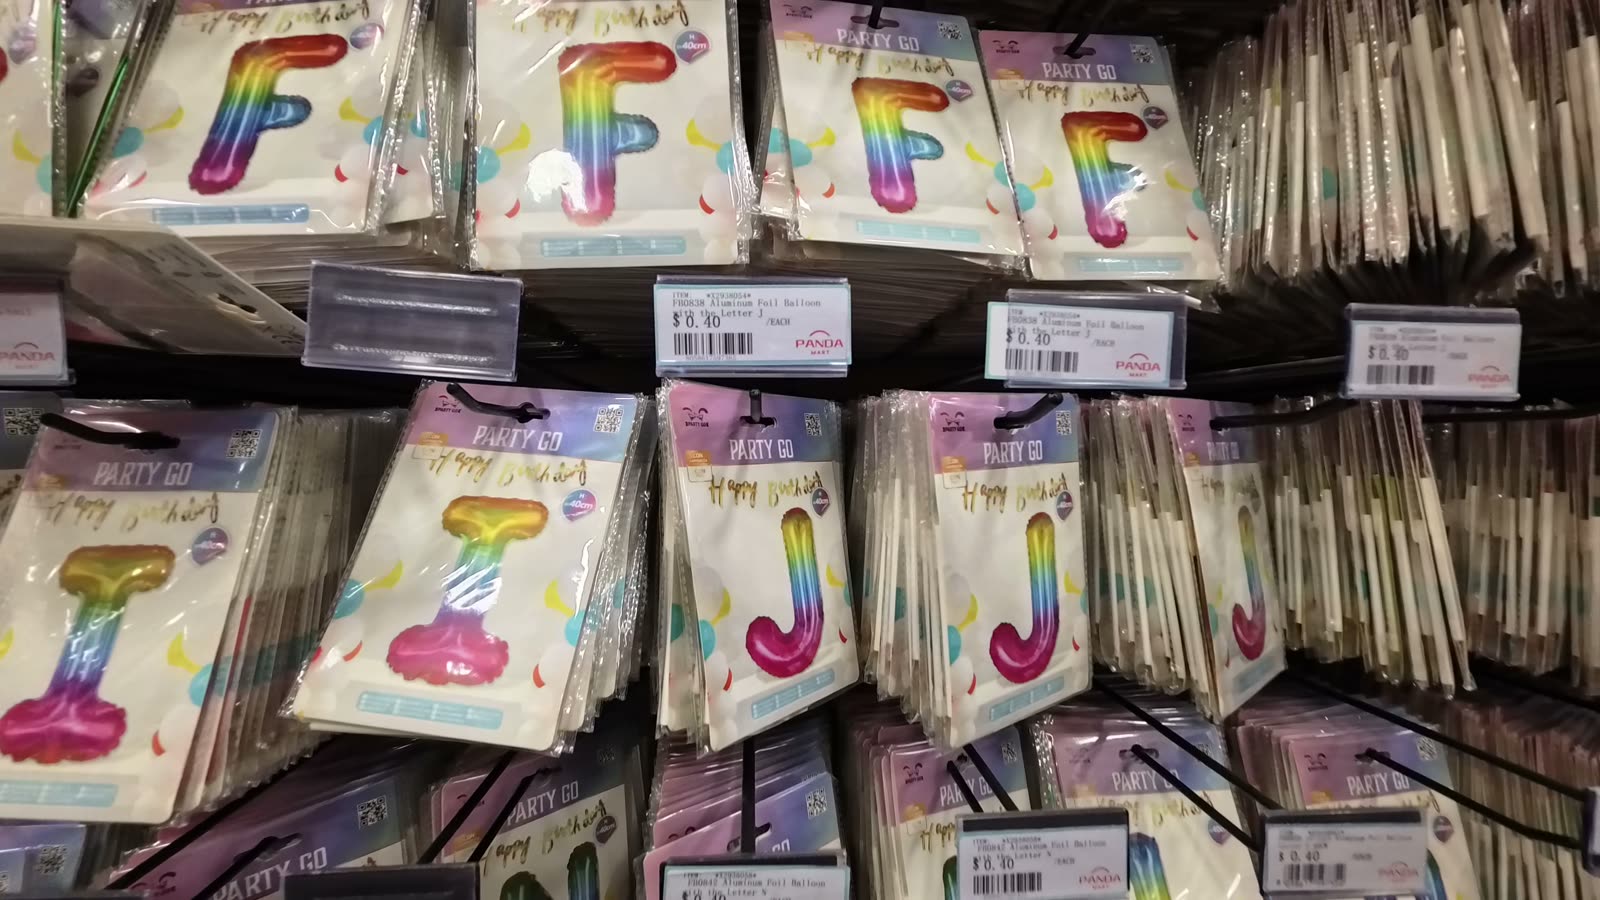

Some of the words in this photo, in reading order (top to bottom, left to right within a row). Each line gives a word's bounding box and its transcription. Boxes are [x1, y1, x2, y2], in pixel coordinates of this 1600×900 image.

[836, 28, 892, 49] PARTY
[897, 35, 920, 52] GO
[1041, 62, 1093, 80] PARTY
[1097, 64, 1117, 81] GO
[672, 299, 705, 308] FB0838
[710, 299, 753, 308] Aluminum
[757, 299, 778, 308] Foil
[784, 299, 822, 308] Balloon
[700, 309, 717, 318] the
[721, 309, 753, 318] Letter
[766, 318, 791, 327] /EACH
[1051, 328, 1081, 337] Letter
[1086, 319, 1105, 329] Foil
[1110, 321, 1145, 331] Balloon
[795, 339, 844, 349] PANDA
[1115, 360, 1161, 372] PANDA
[472, 425, 536, 450] PARTY
[537, 431, 564, 451] GO
[729, 438, 773, 461] PARTY
[777, 438, 794, 459] GO
[983, 440, 1024, 465] PARTY
[1028, 440, 1043, 461] GO
[92, 461, 163, 486] PARTY
[163, 462, 193, 486] GO
[939, 776, 976, 808] PARY
[1111, 770, 1158, 792] PARTY
[1346, 773, 1389, 797] PARTY
[506, 788, 557, 827] PARTY
[561, 780, 579, 801] GO
[300, 846, 328, 874] GO
[1078, 873, 1122, 884] PANDA
